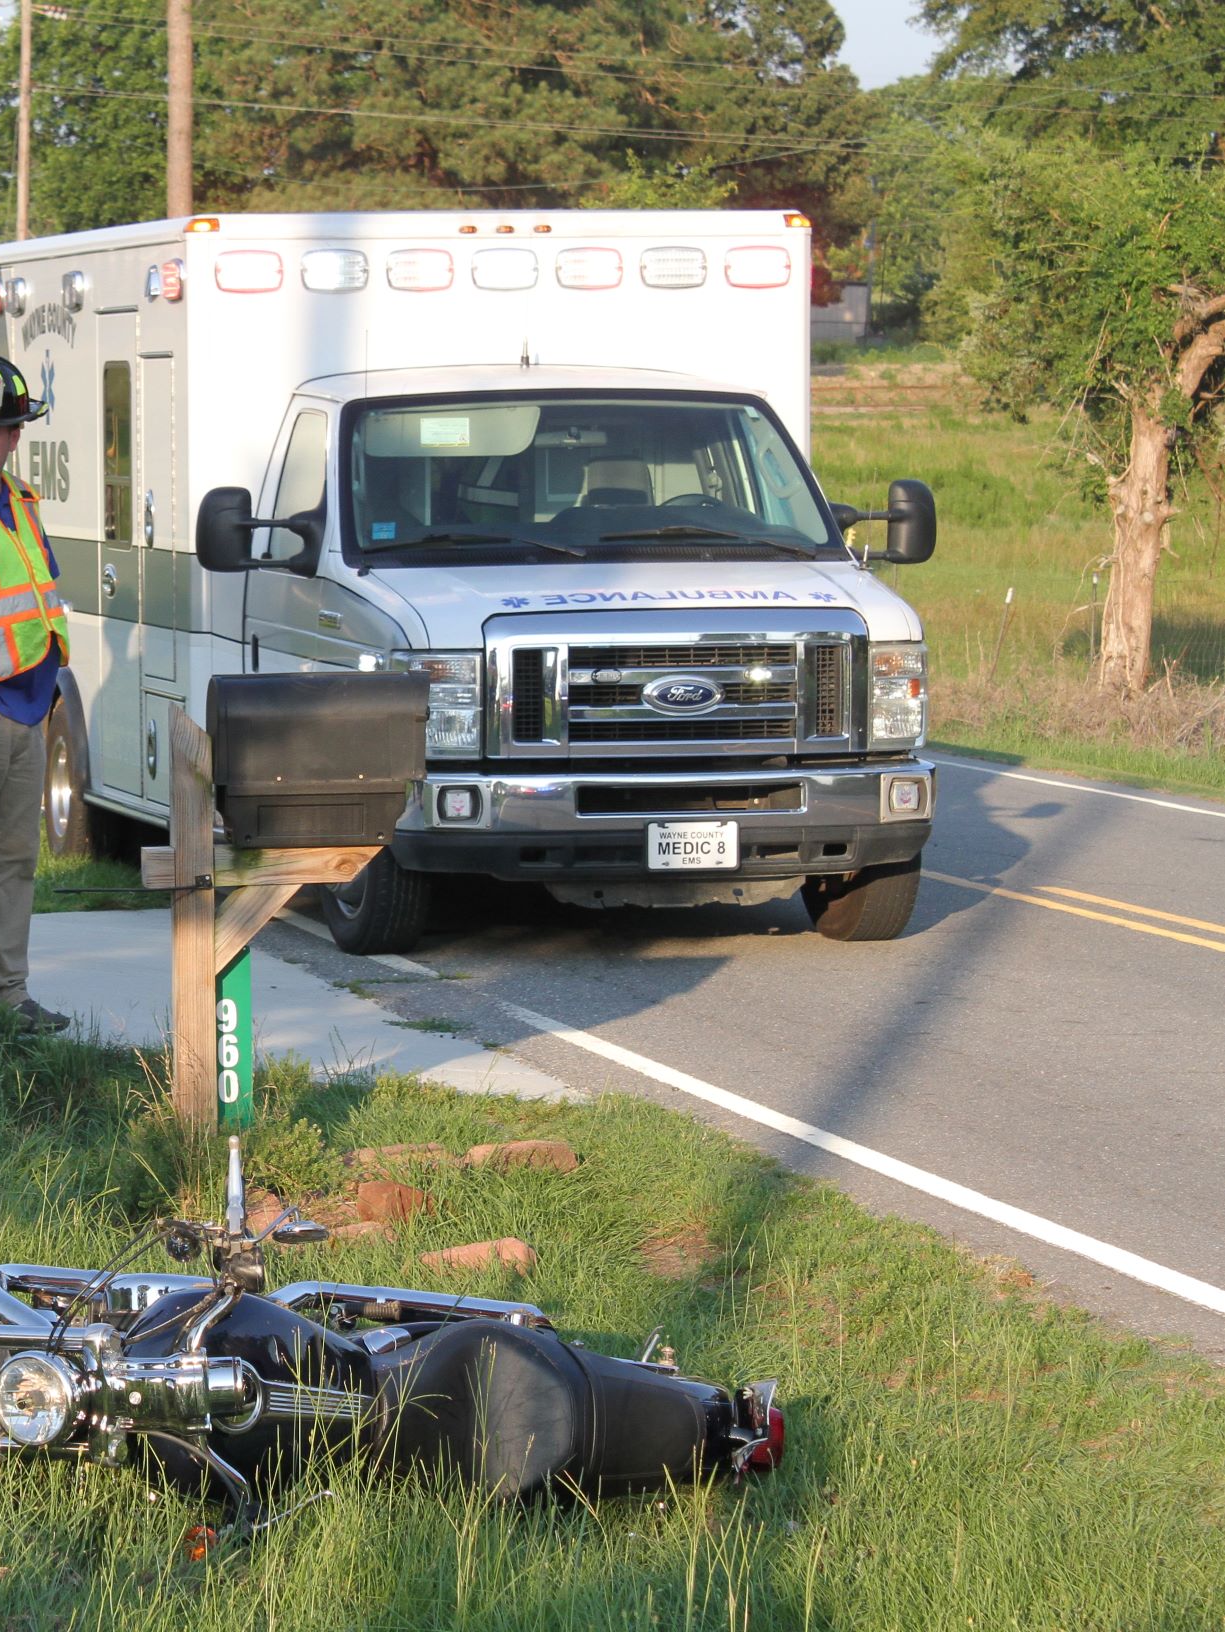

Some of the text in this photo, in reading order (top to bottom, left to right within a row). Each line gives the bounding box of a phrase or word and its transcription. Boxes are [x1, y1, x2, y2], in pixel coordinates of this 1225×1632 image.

[47, 302, 77, 349] COUNTY
[29, 440, 70, 503] EMS
[667, 686, 703, 701] Ford
[659, 831, 724, 840] WAYNE COUNTY
[658, 841, 726, 855] MEDIC 8
[682, 857, 702, 865] EMS
[216, 998, 239, 1104] 960
